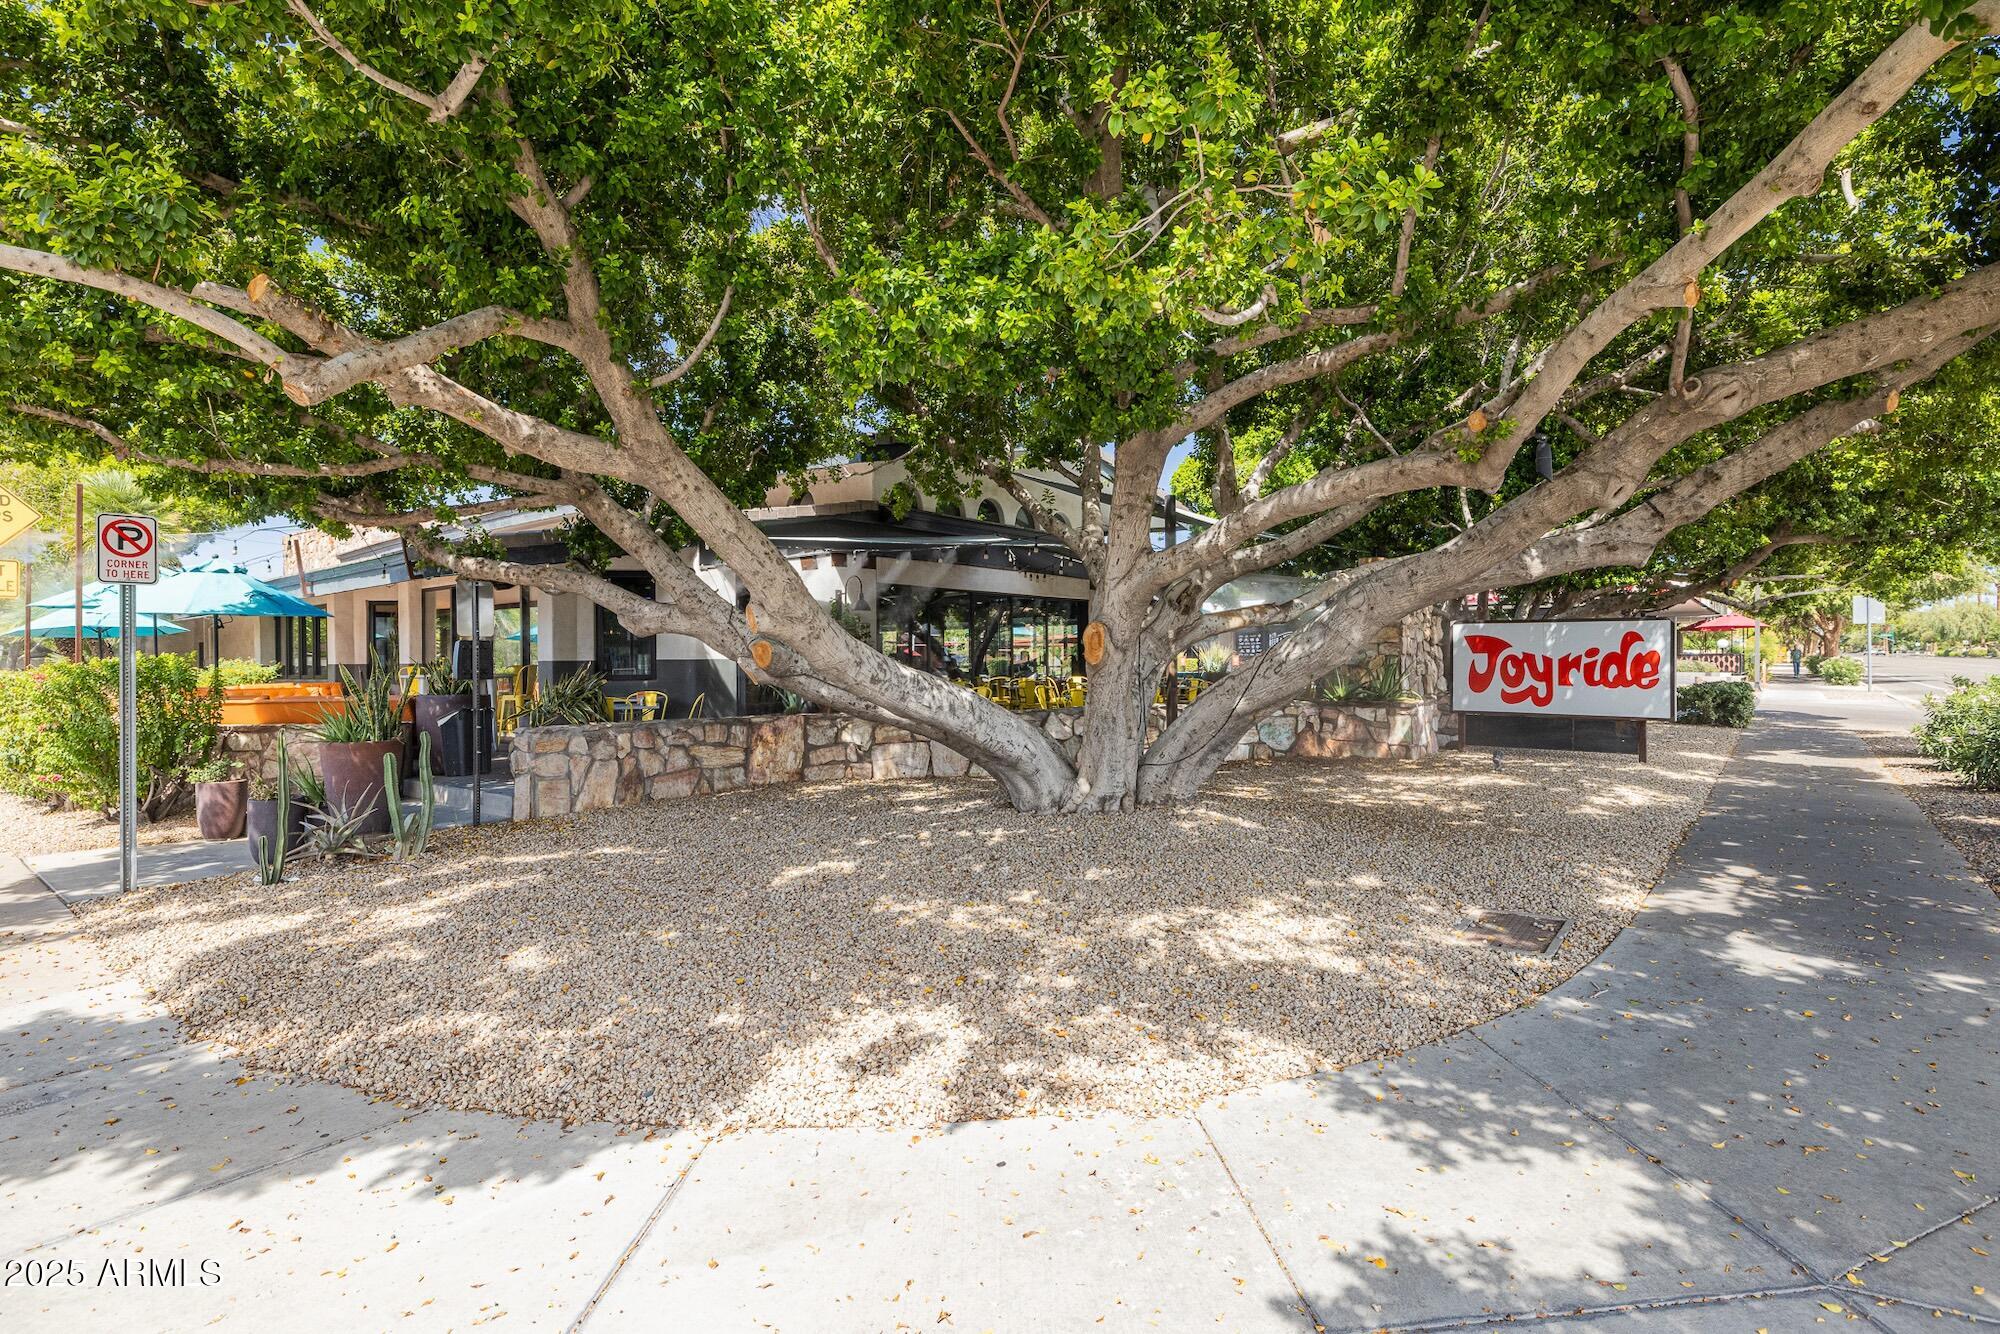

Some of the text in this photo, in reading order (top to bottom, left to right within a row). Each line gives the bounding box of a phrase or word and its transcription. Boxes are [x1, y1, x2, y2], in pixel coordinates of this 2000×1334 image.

[106, 559, 149, 569] CORNER
[105, 568, 150, 580] TO HERE
[1464, 630, 1661, 708] Joyride
